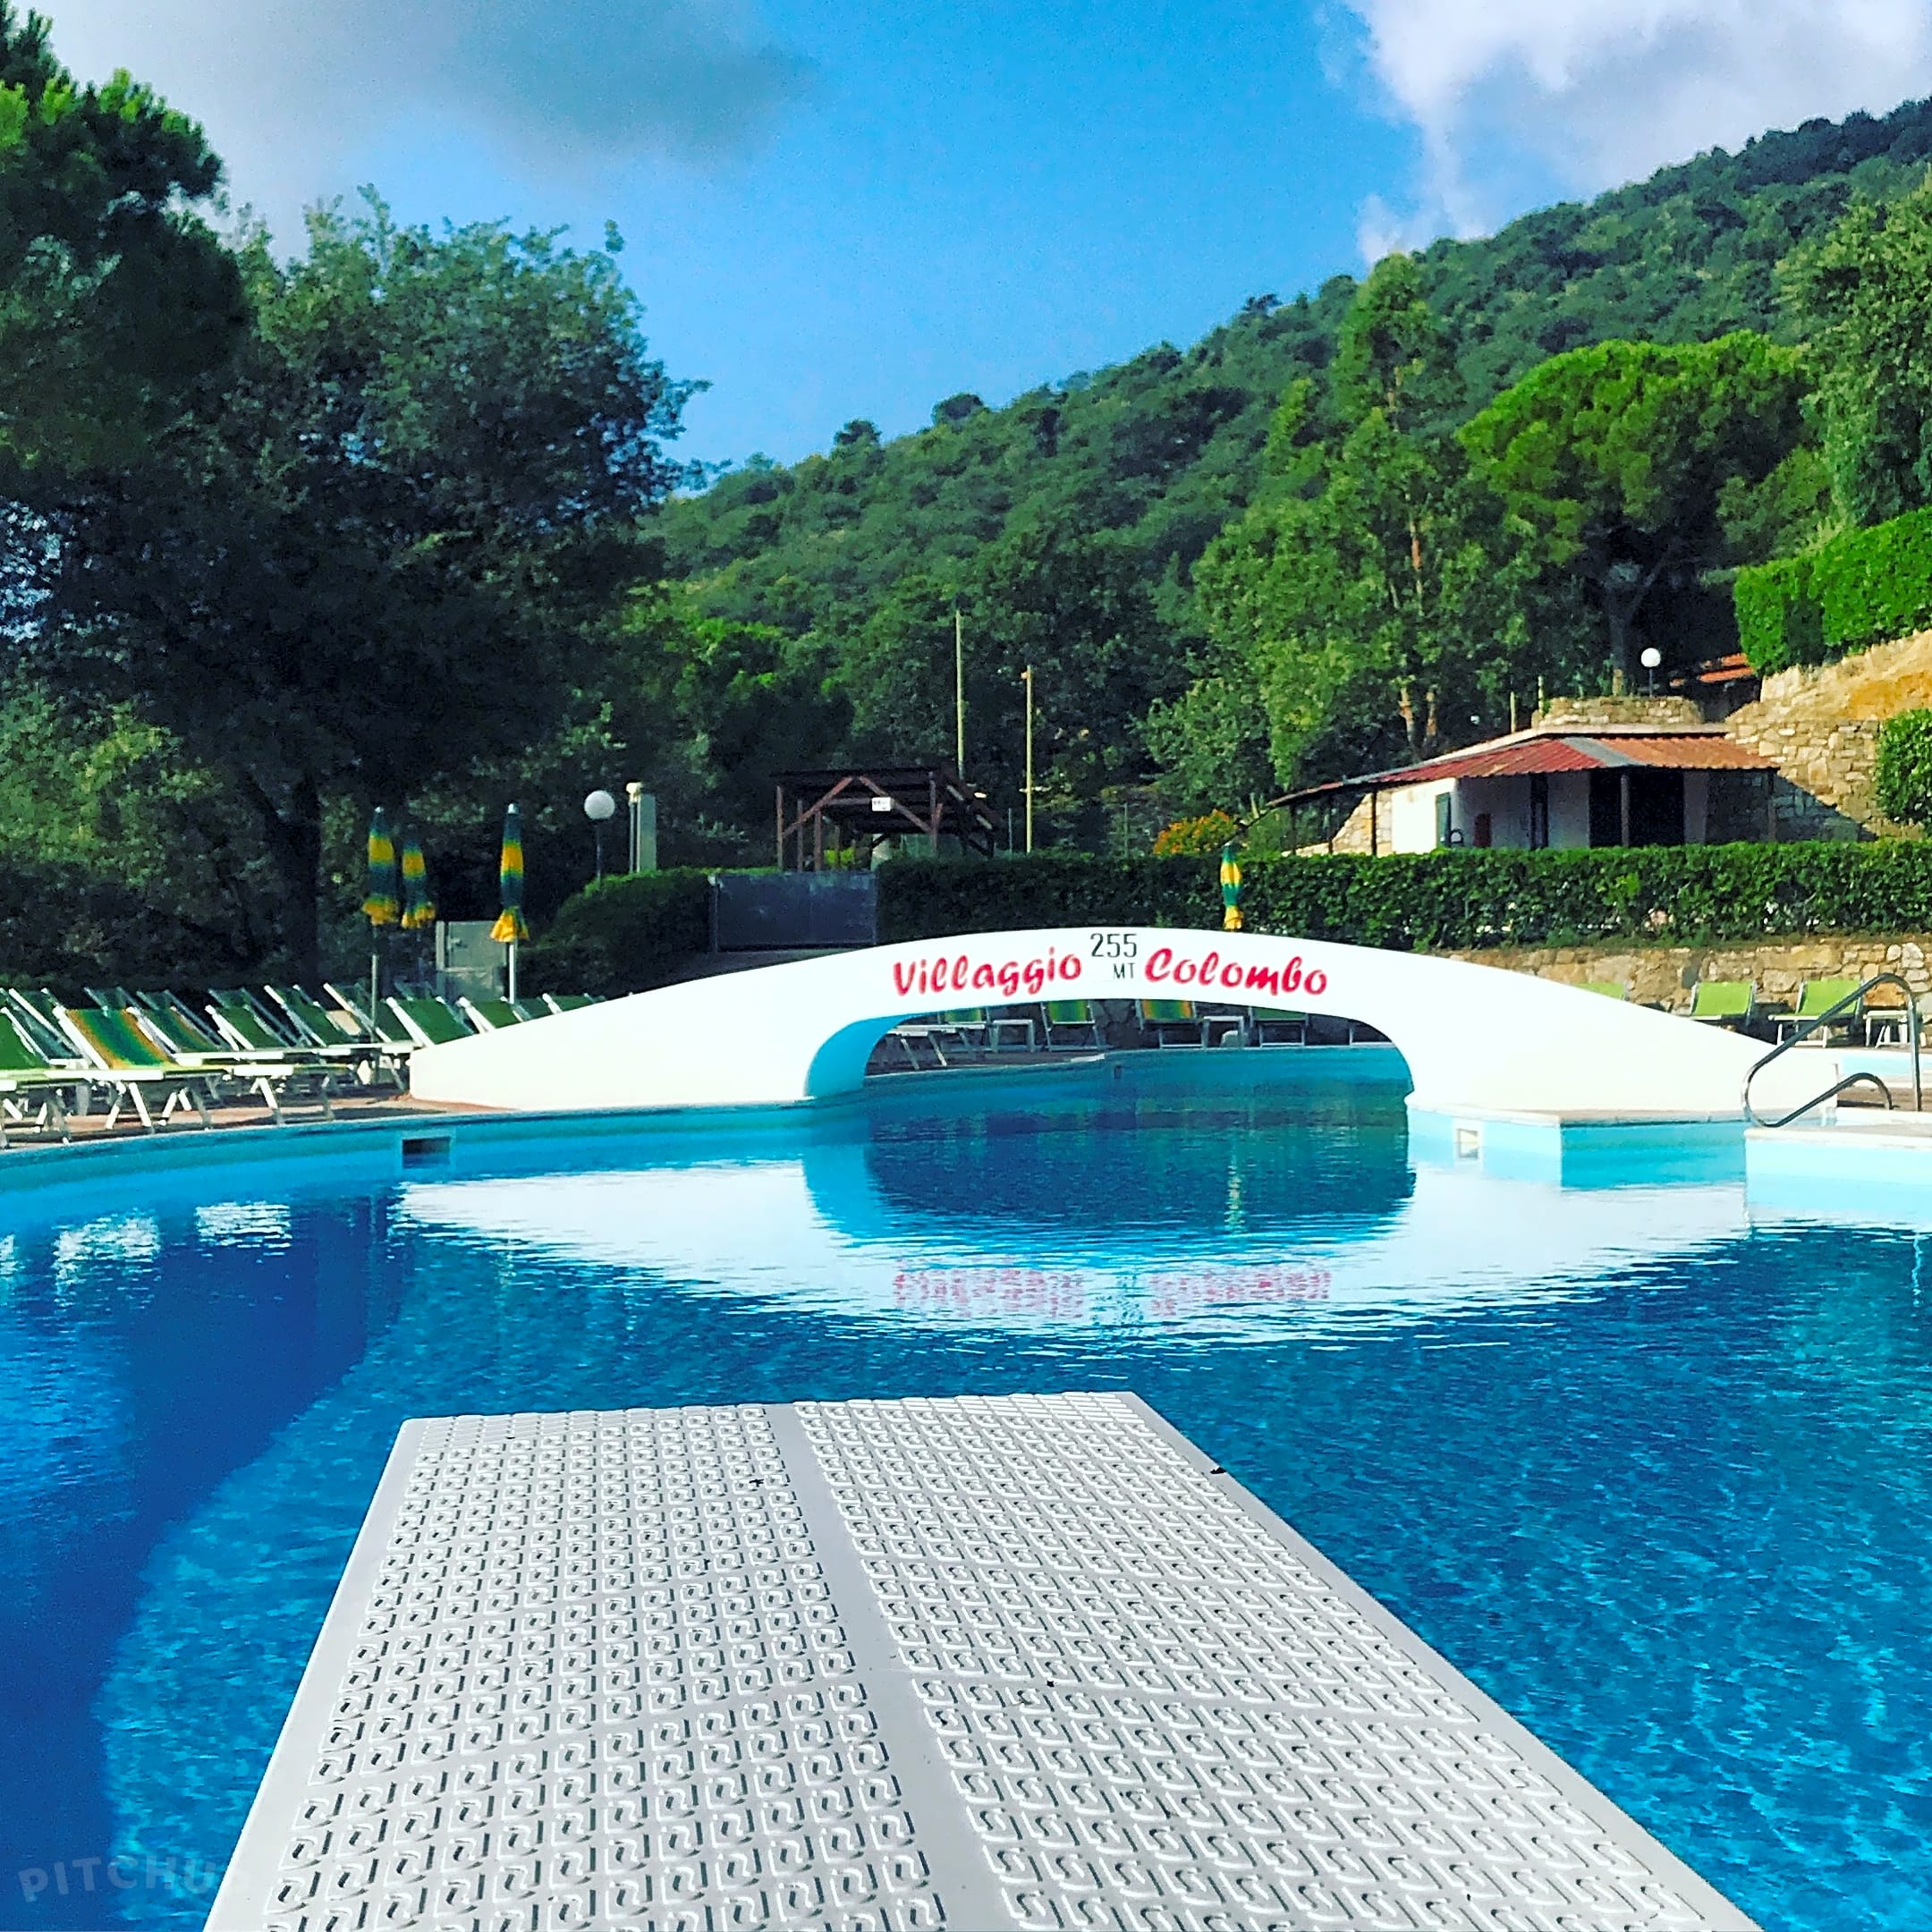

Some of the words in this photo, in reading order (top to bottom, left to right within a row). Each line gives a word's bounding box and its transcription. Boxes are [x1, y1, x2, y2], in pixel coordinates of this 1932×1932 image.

[1089, 933, 1137, 958] 255
[893, 946, 1082, 997] Villaggio
[1144, 947, 1327, 996] Colombo
[1113, 962, 1135, 979] MT
